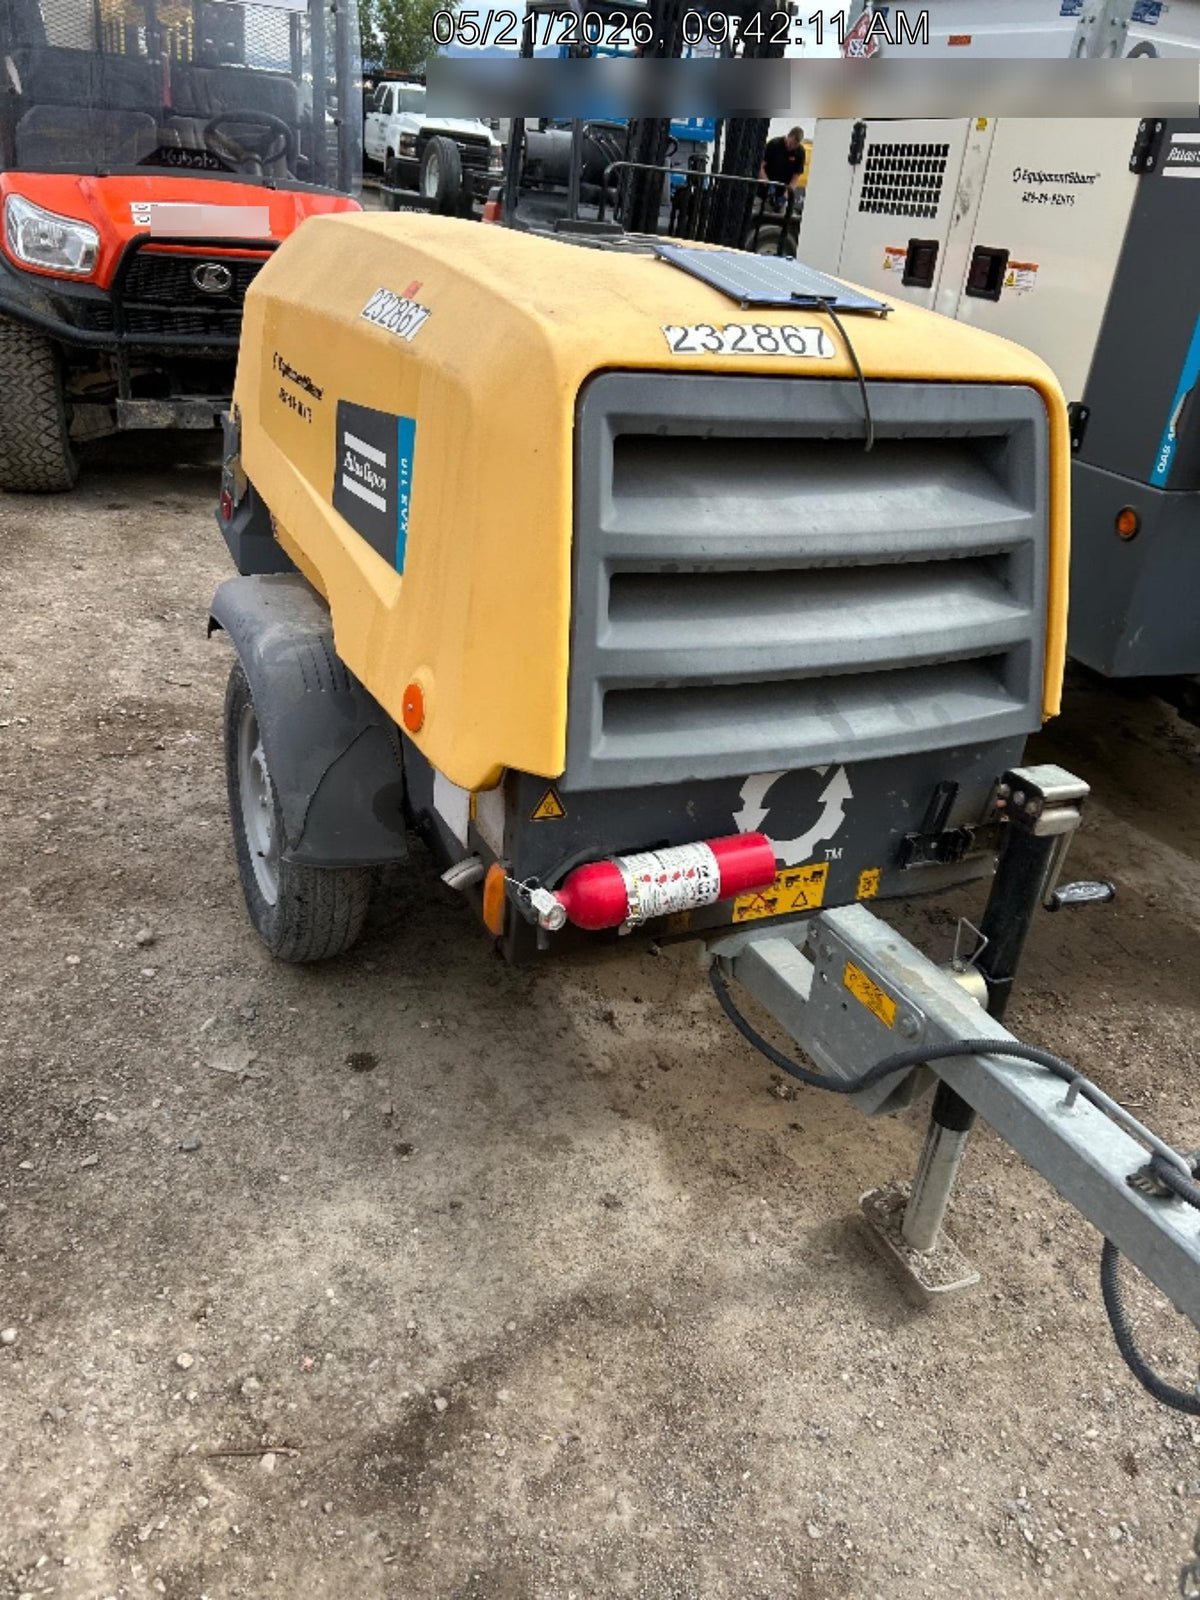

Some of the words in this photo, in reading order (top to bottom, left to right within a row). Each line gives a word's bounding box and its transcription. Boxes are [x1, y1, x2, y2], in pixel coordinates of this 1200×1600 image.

[162, 151, 220, 168] Kubota
[362, 288, 432, 338] 232867
[665, 323, 825, 355] 232867
